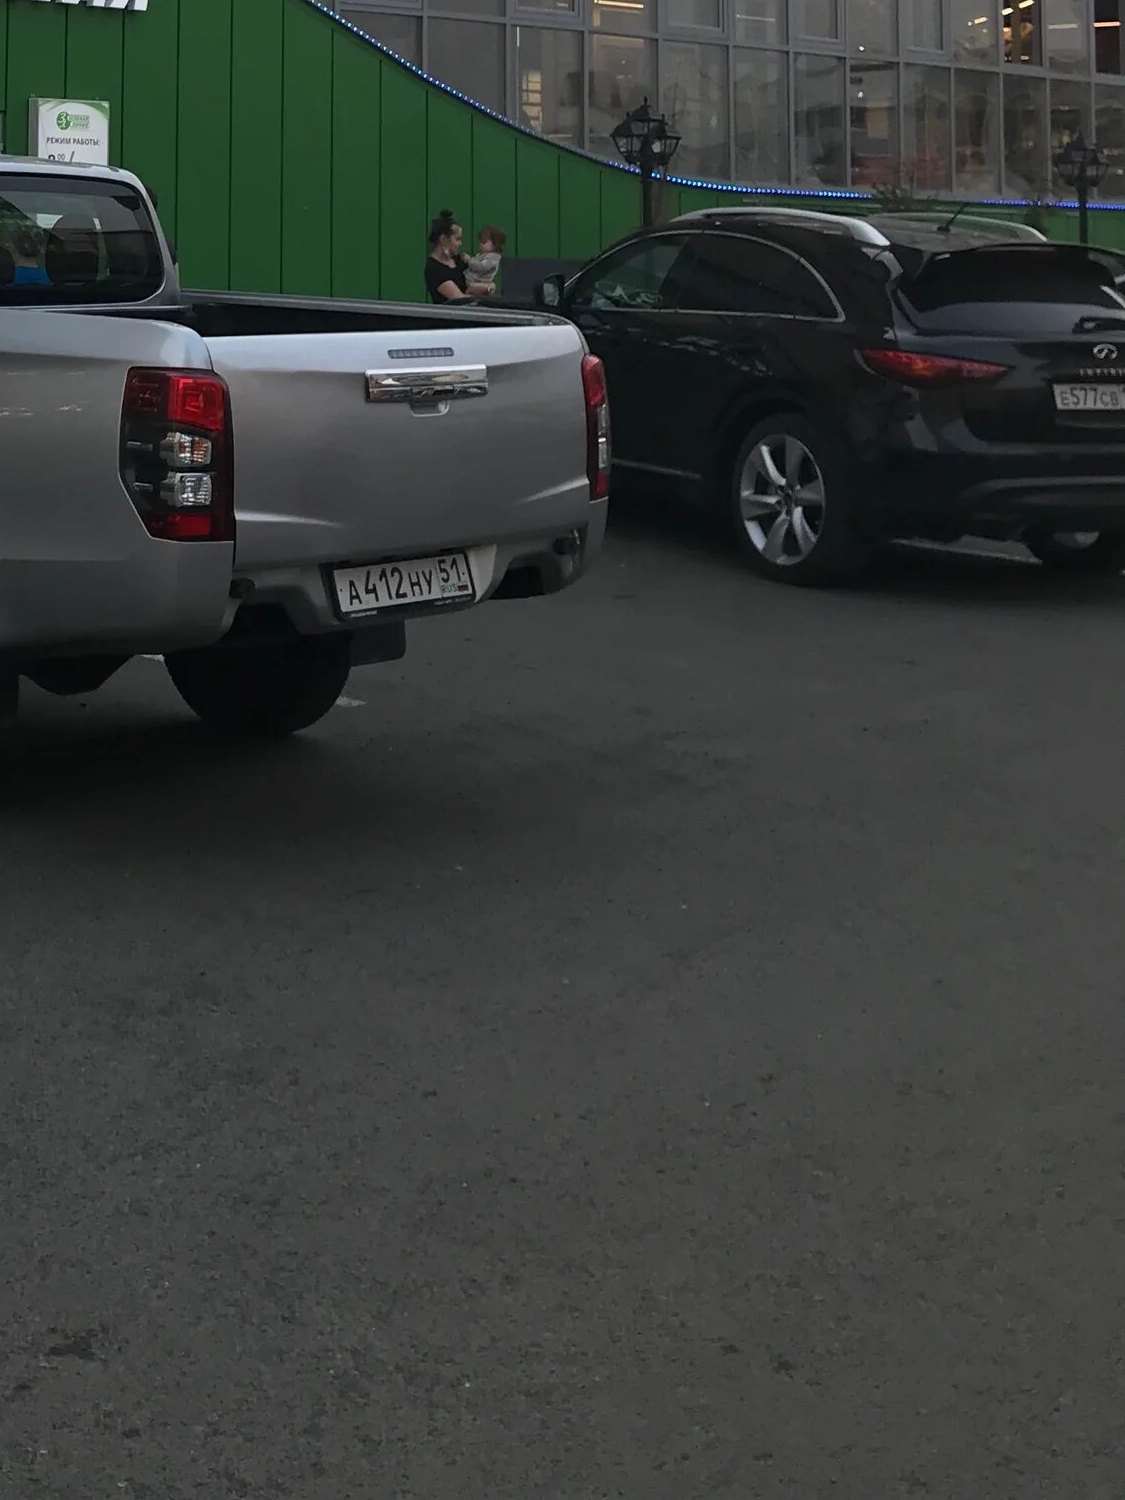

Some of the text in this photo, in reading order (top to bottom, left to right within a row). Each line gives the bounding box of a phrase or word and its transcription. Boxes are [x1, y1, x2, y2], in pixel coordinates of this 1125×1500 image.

[46, 137, 71, 145] РЕЖИМ
[348, 557, 462, 606] А412НУ 51
